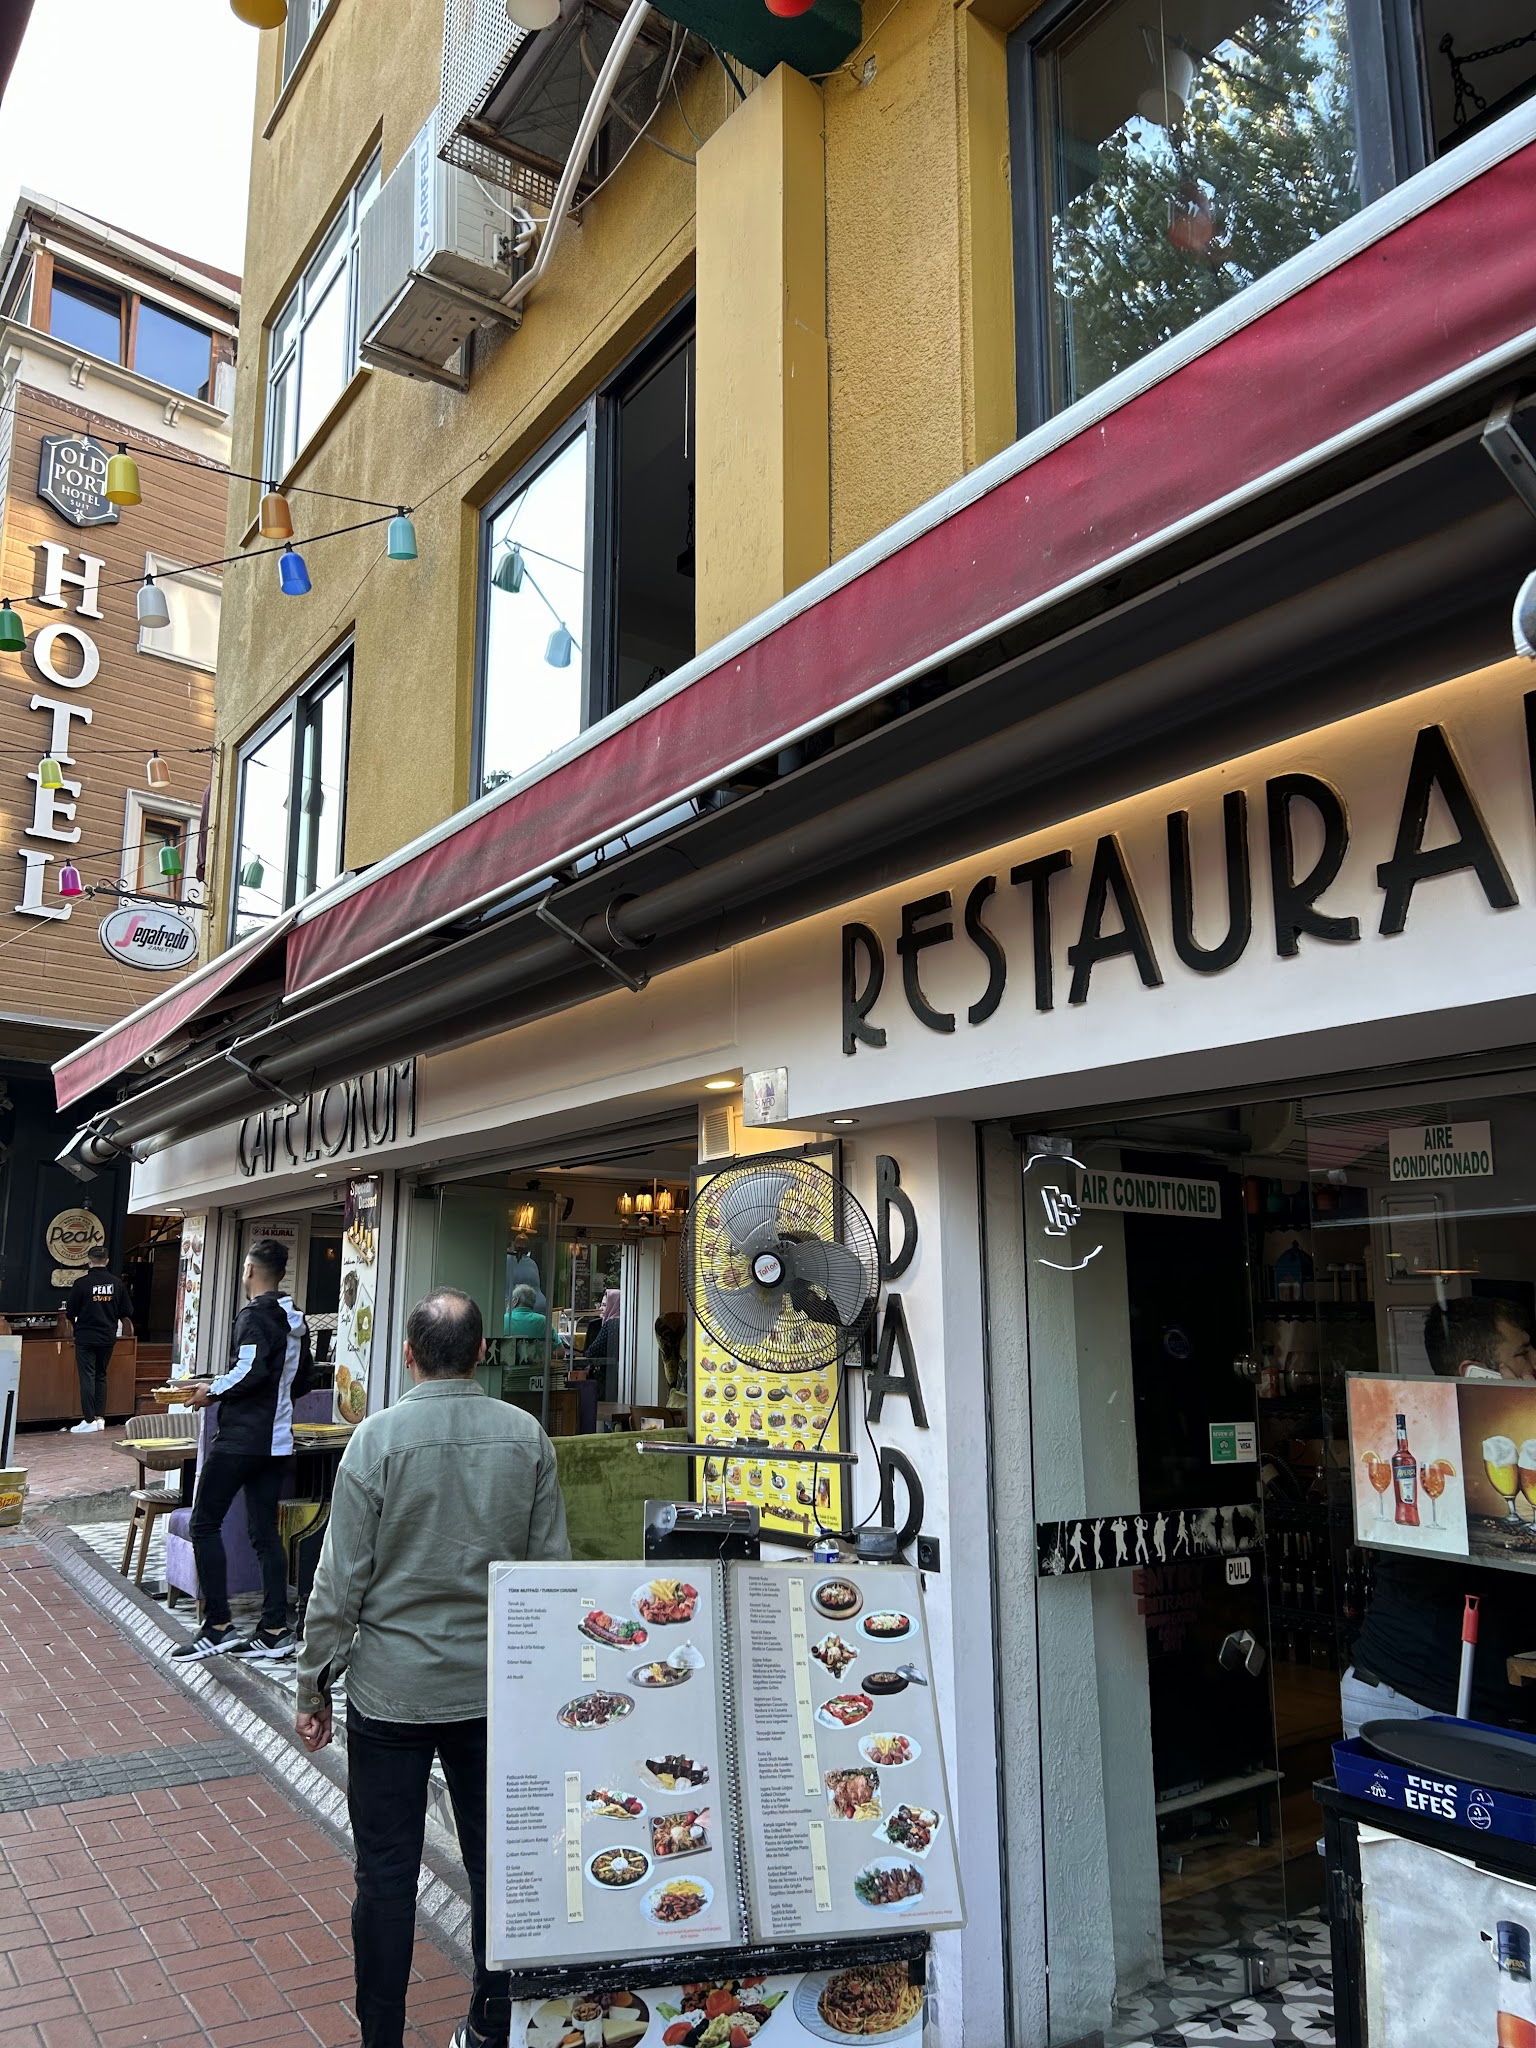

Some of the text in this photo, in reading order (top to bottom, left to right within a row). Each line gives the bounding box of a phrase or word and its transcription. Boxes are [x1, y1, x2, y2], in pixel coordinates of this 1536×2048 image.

[420, 141, 429, 228] AIRFEL
[60, 447, 106, 475] OLD
[54, 462, 107, 497] PORT
[61, 484, 101, 507] HOTEL
[70, 499, 90, 511] SUIT
[14, 540, 106, 921] HOTEL
[842, 690, 1536, 1055] RESTAURA
[114, 915, 189, 950] Segafredo
[147, 945, 175, 954] ZANETTI
[1424, 1126, 1454, 1150] AIRE
[1393, 1150, 1490, 1179] CONDICIONADO
[1081, 1174, 1217, 1214] AIR CONDITIONED
[50, 1225, 104, 1245] Peak
[93, 1284, 114, 1295] PEAK
[1228, 1561, 1250, 1581] PULL
[1404, 1787, 1457, 1820] EFES
